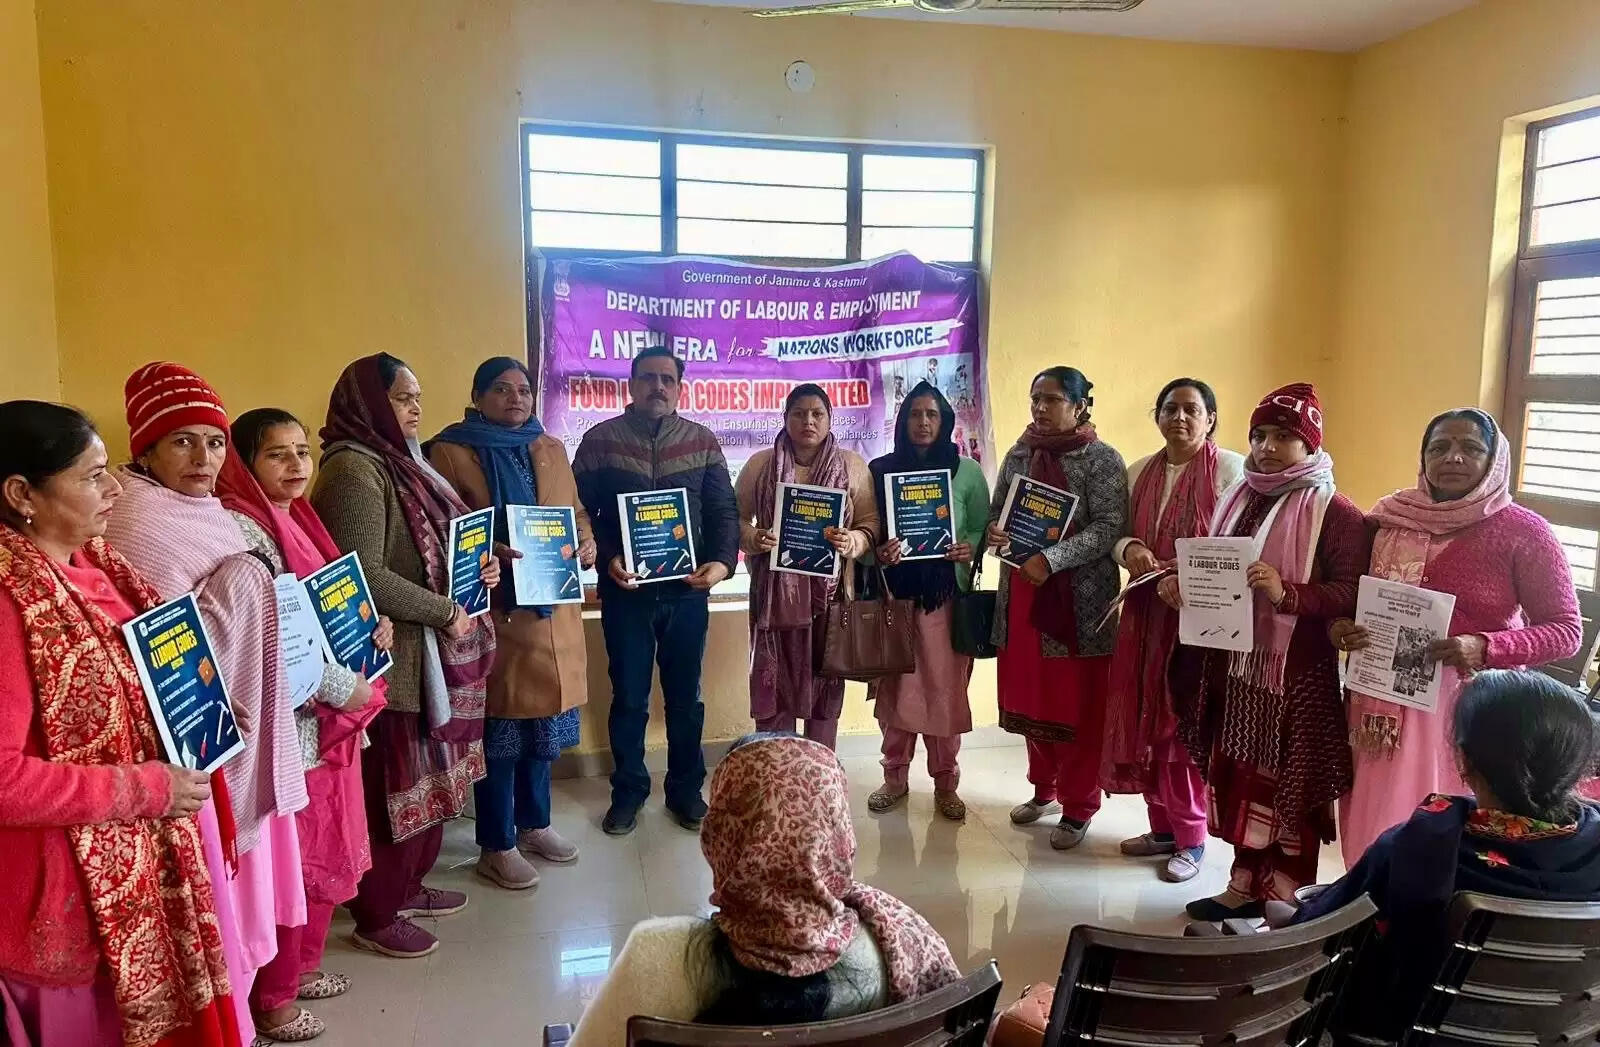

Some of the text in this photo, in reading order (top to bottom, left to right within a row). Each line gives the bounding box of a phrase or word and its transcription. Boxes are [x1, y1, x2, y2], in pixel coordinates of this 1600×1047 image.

[682, 269, 867, 288] Government of Jammu & Kashmir
[606, 289, 921, 320] DEPARTMENT OF LABOUR & EMPLOYMENT
[589, 329, 606, 359] A
[673, 336, 718, 362] ERA
[777, 336, 839, 357] NATIONS
[843, 326, 933, 353] WORKFORCE
[570, 380, 617, 410] FOUR
[694, 381, 749, 411] CODES
[753, 380, 870, 410] IMPNTED
[723, 418, 768, 431] Ensuring
[1194, 560, 1217, 569] LABOUR
[1220, 561, 1239, 570] CODES
